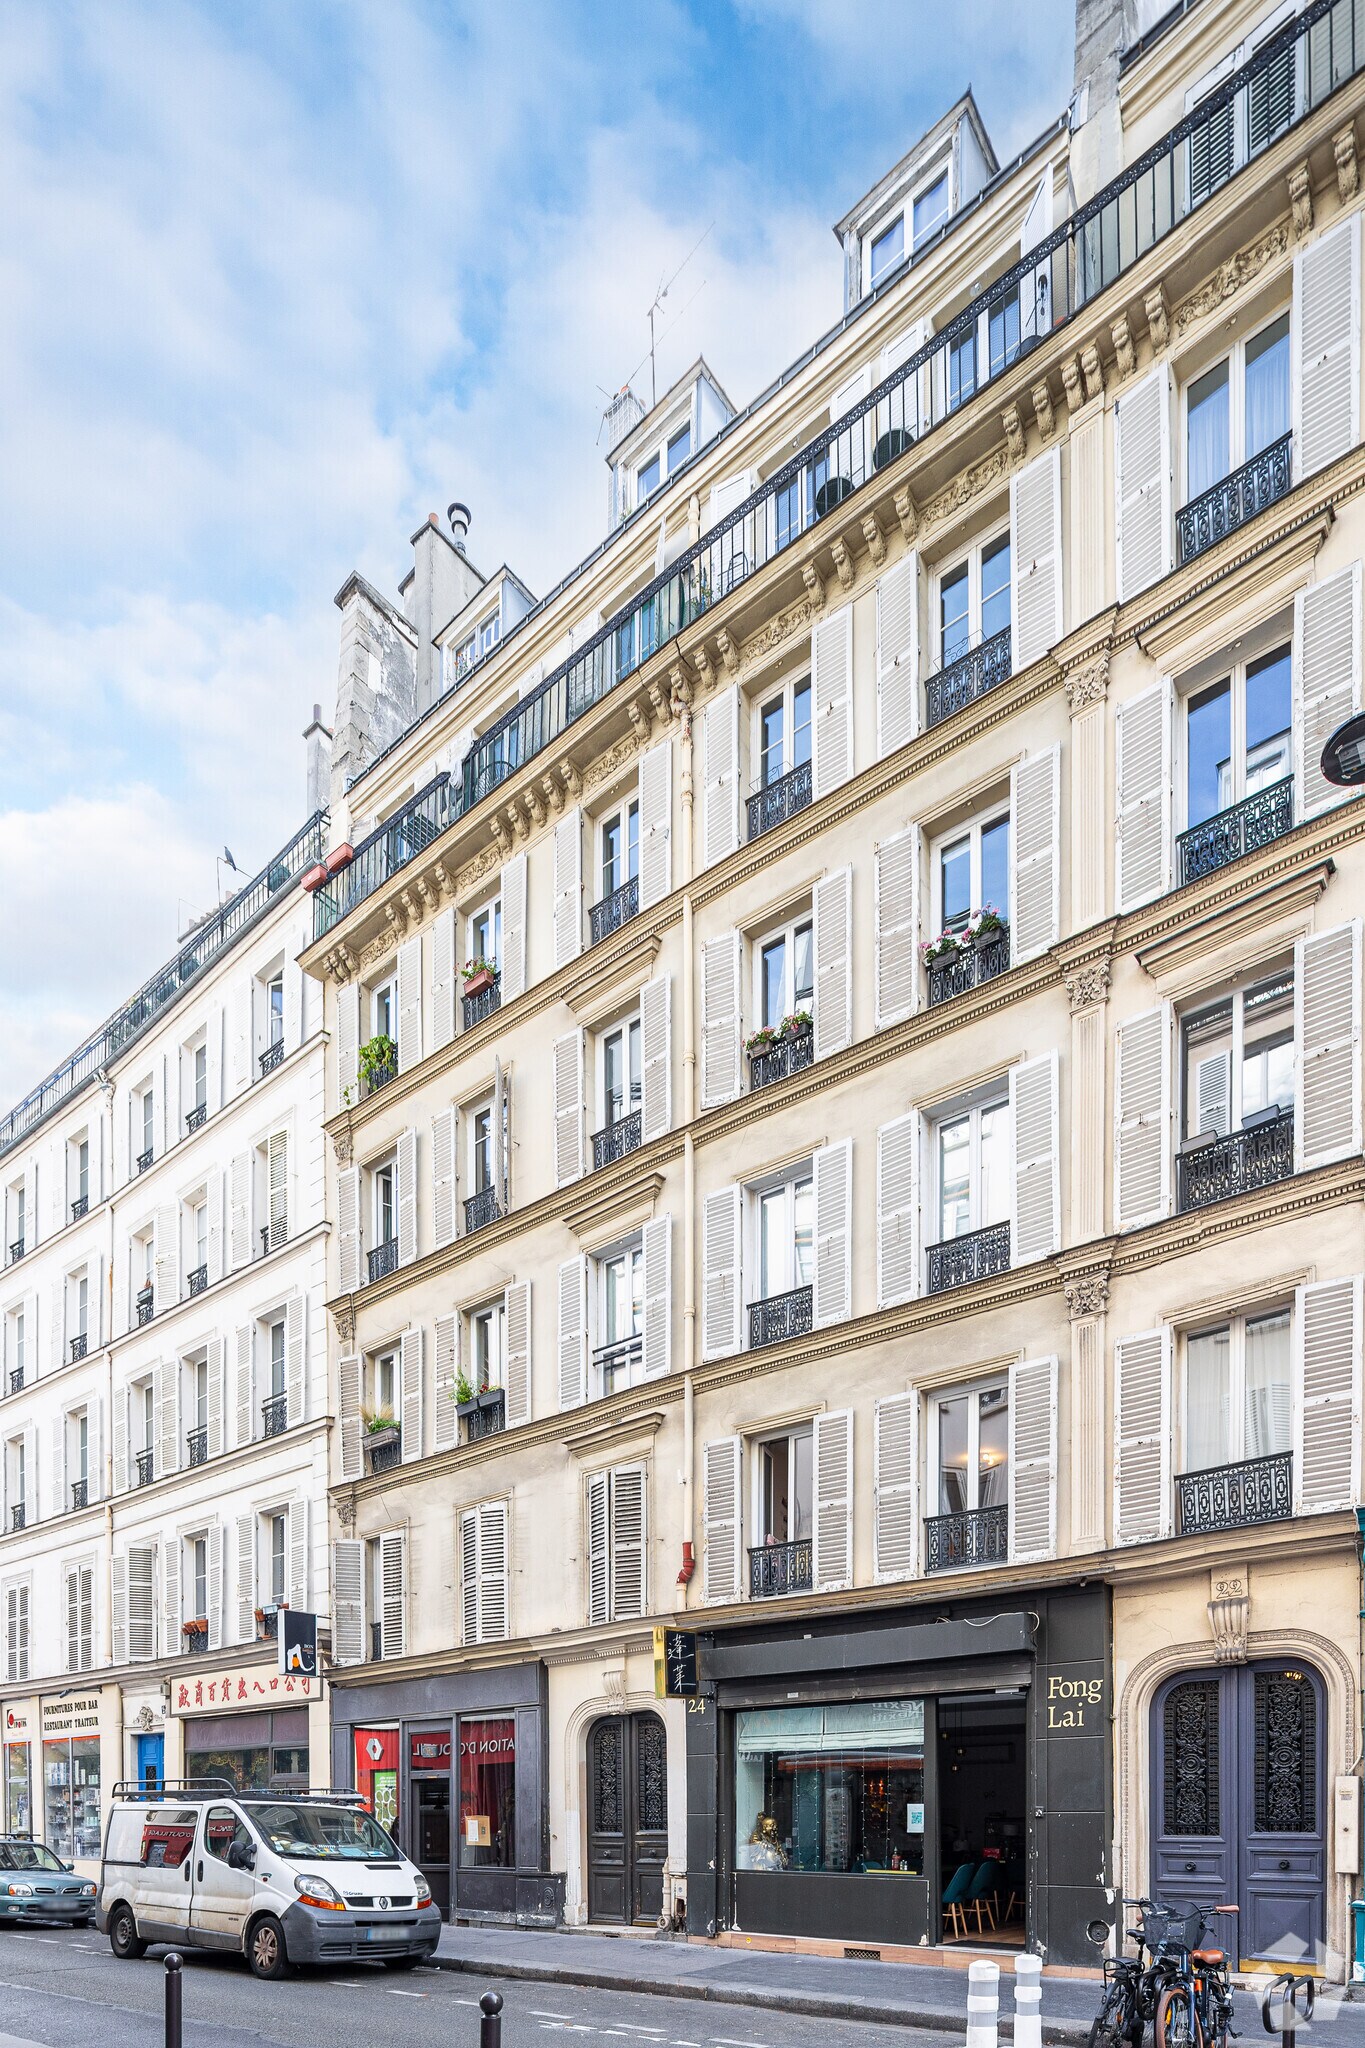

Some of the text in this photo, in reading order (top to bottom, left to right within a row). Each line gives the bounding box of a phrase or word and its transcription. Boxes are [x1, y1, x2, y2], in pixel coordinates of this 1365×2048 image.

[1216, 1579, 1242, 1599] 22
[1048, 1676, 1104, 1704] Fong
[43, 1699, 98, 1716] FOURNITURES POUR BAR
[688, 1699, 706, 1715] 24
[1048, 1702, 1085, 1728] Lai
[44, 1716, 98, 1731] RESTAURANT TRAITEUR
